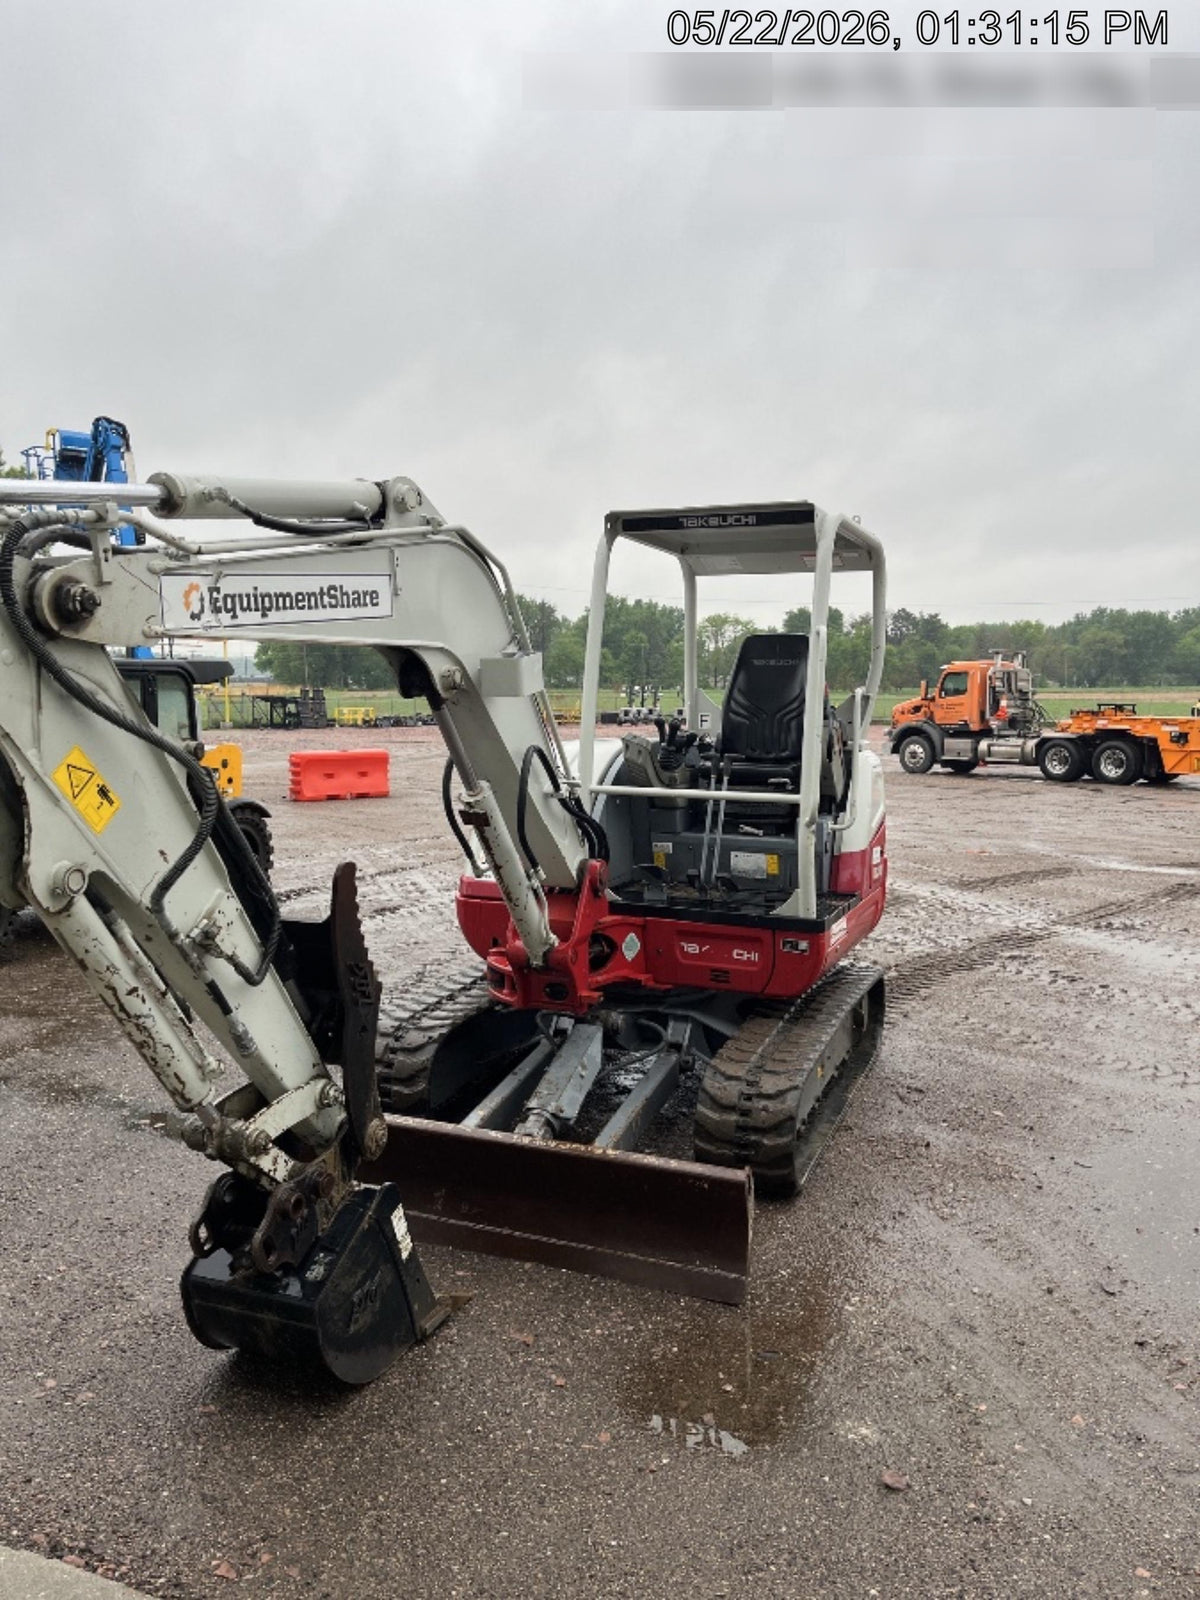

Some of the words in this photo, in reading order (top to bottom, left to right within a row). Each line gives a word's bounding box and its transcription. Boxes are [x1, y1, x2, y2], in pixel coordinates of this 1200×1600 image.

[679, 515, 757, 528] TAKEUCHI
[208, 585, 380, 620] EquipmentShare
[700, 714, 711, 728] F
